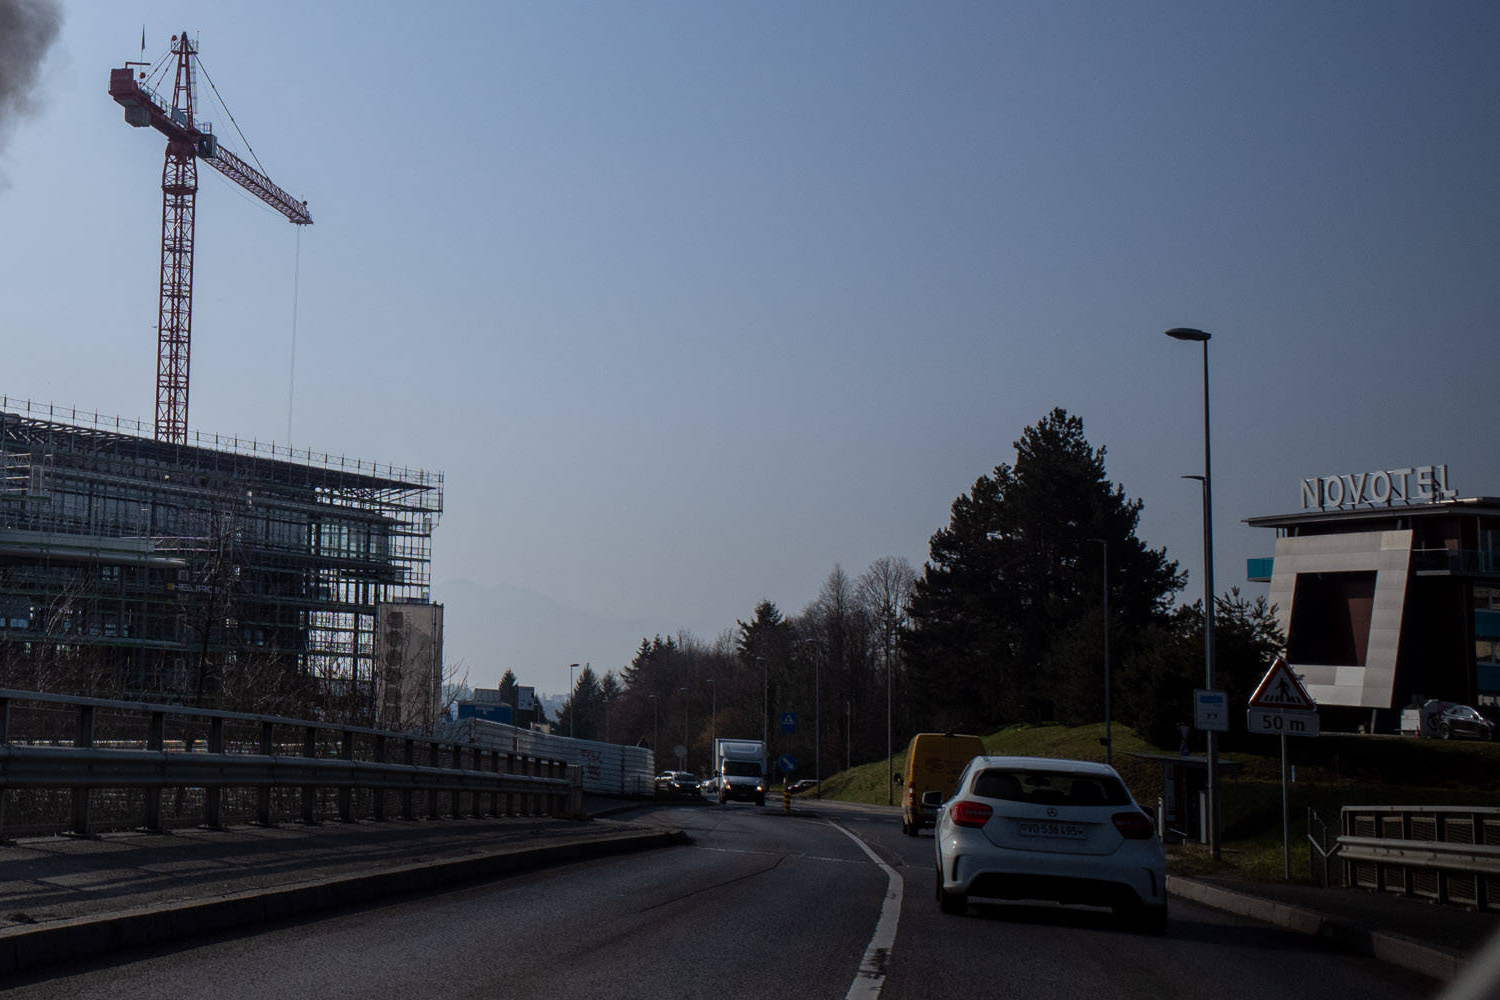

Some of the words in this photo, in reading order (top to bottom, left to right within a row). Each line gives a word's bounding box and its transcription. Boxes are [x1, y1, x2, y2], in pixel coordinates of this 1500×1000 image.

[1300, 464, 1458, 509] NOVOTEL
[1263, 715, 1283, 730] 50
[1290, 719, 1305, 731] m
